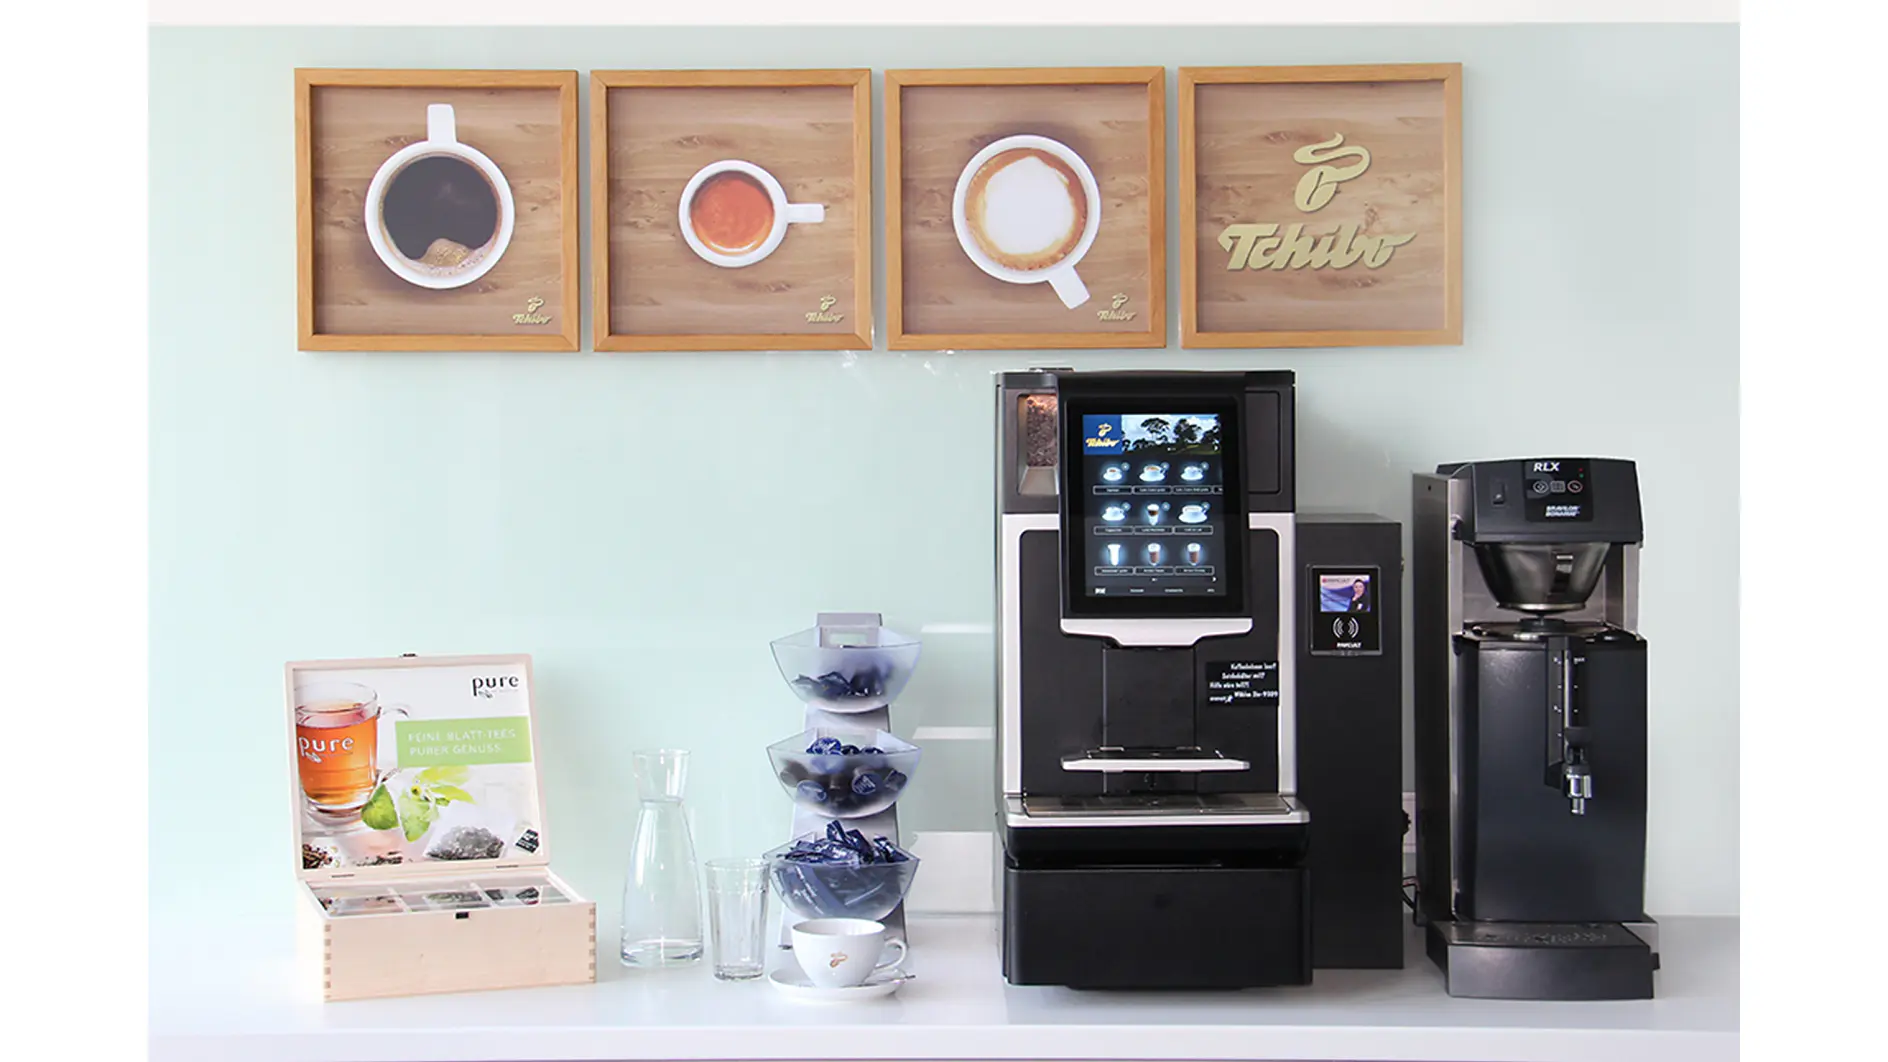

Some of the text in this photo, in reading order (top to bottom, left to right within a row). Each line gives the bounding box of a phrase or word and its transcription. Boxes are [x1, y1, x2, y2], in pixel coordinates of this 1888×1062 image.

[1217, 223, 1417, 271] Tchibo
[513, 313, 552, 325] Tchibo
[805, 311, 844, 323] Tchibo
[1096, 309, 1137, 322] Tchibo
[1085, 437, 1120, 448] Tchibo
[1533, 461, 1560, 472] RLX
[472, 675, 519, 697] pure
[298, 736, 354, 757] pure
[409, 744, 449, 757] PURER
